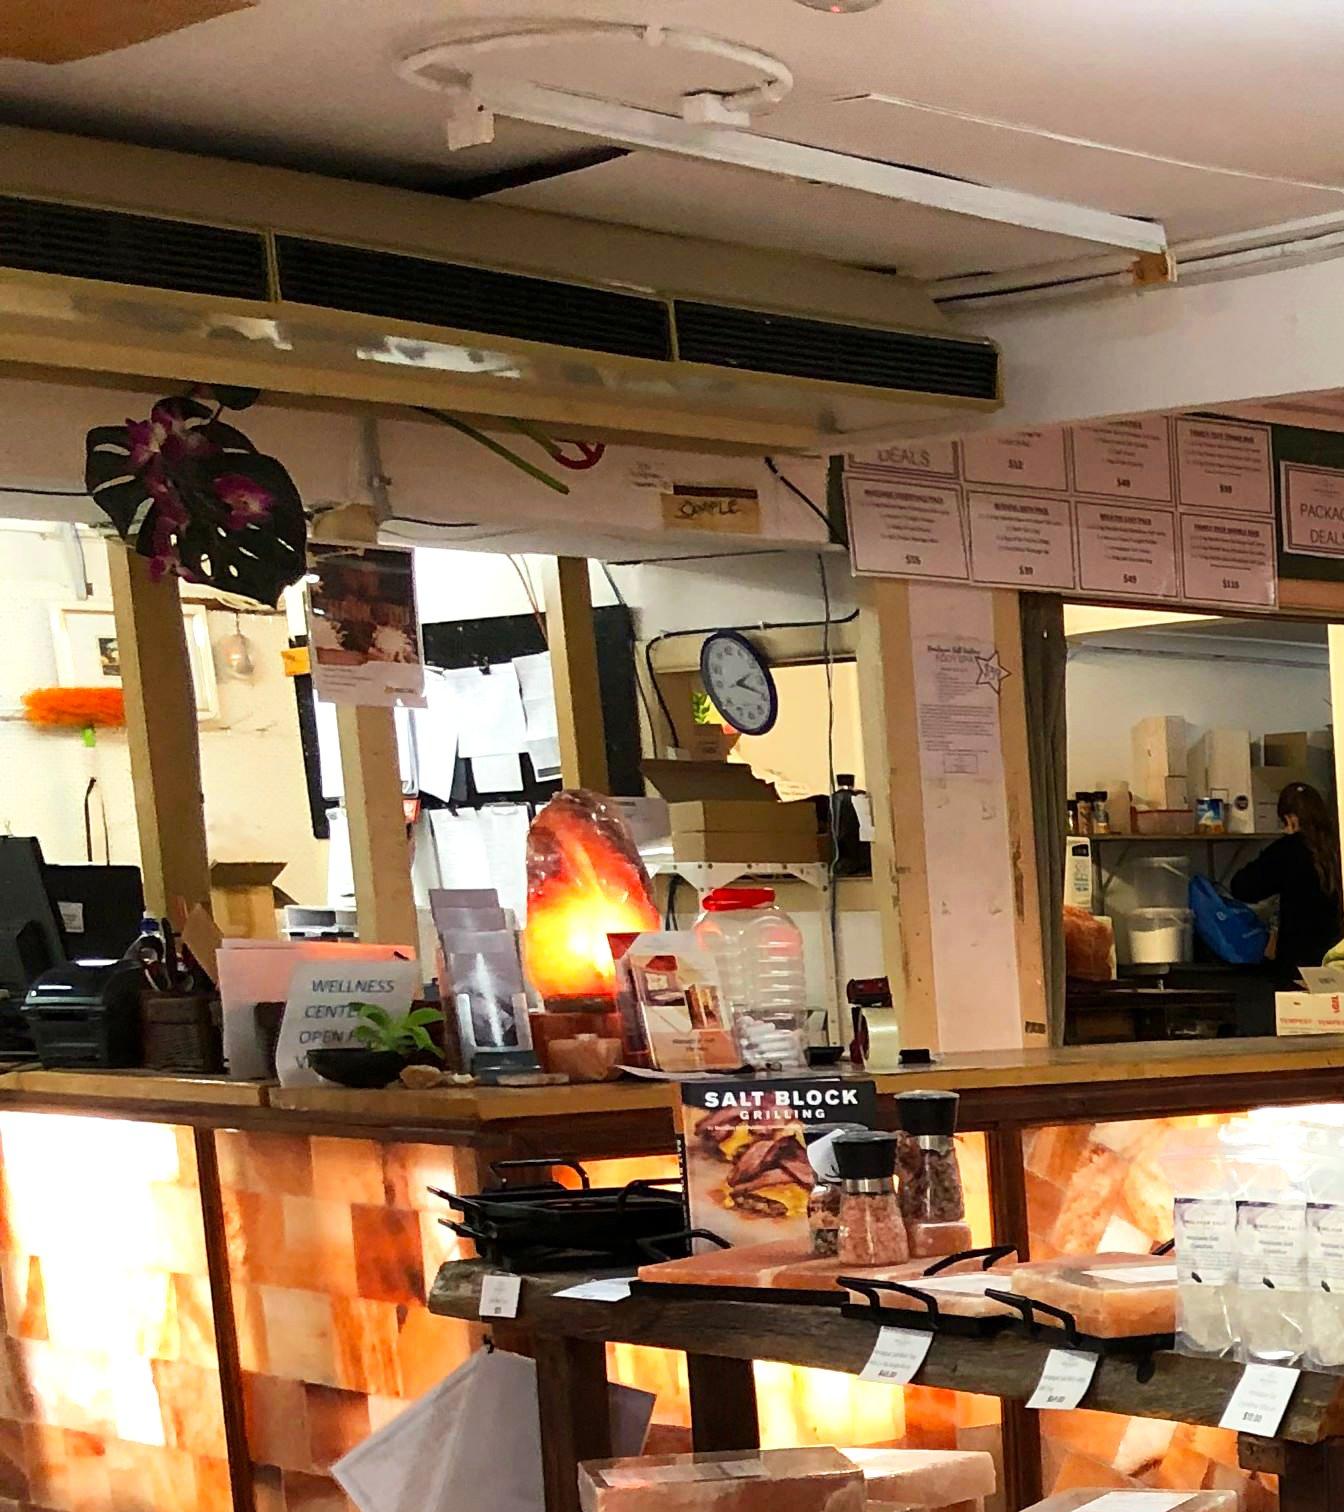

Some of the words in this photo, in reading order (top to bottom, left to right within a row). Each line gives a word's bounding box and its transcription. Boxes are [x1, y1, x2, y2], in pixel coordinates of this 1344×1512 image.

[877, 447, 930, 467] DEALS
[312, 979, 395, 993] WELLNESS
[299, 1030, 344, 1044] OPEN
[704, 1091, 764, 1108] SALT
[775, 1089, 858, 1106] BLOCK
[739, 1108, 826, 1120] GRILLING
